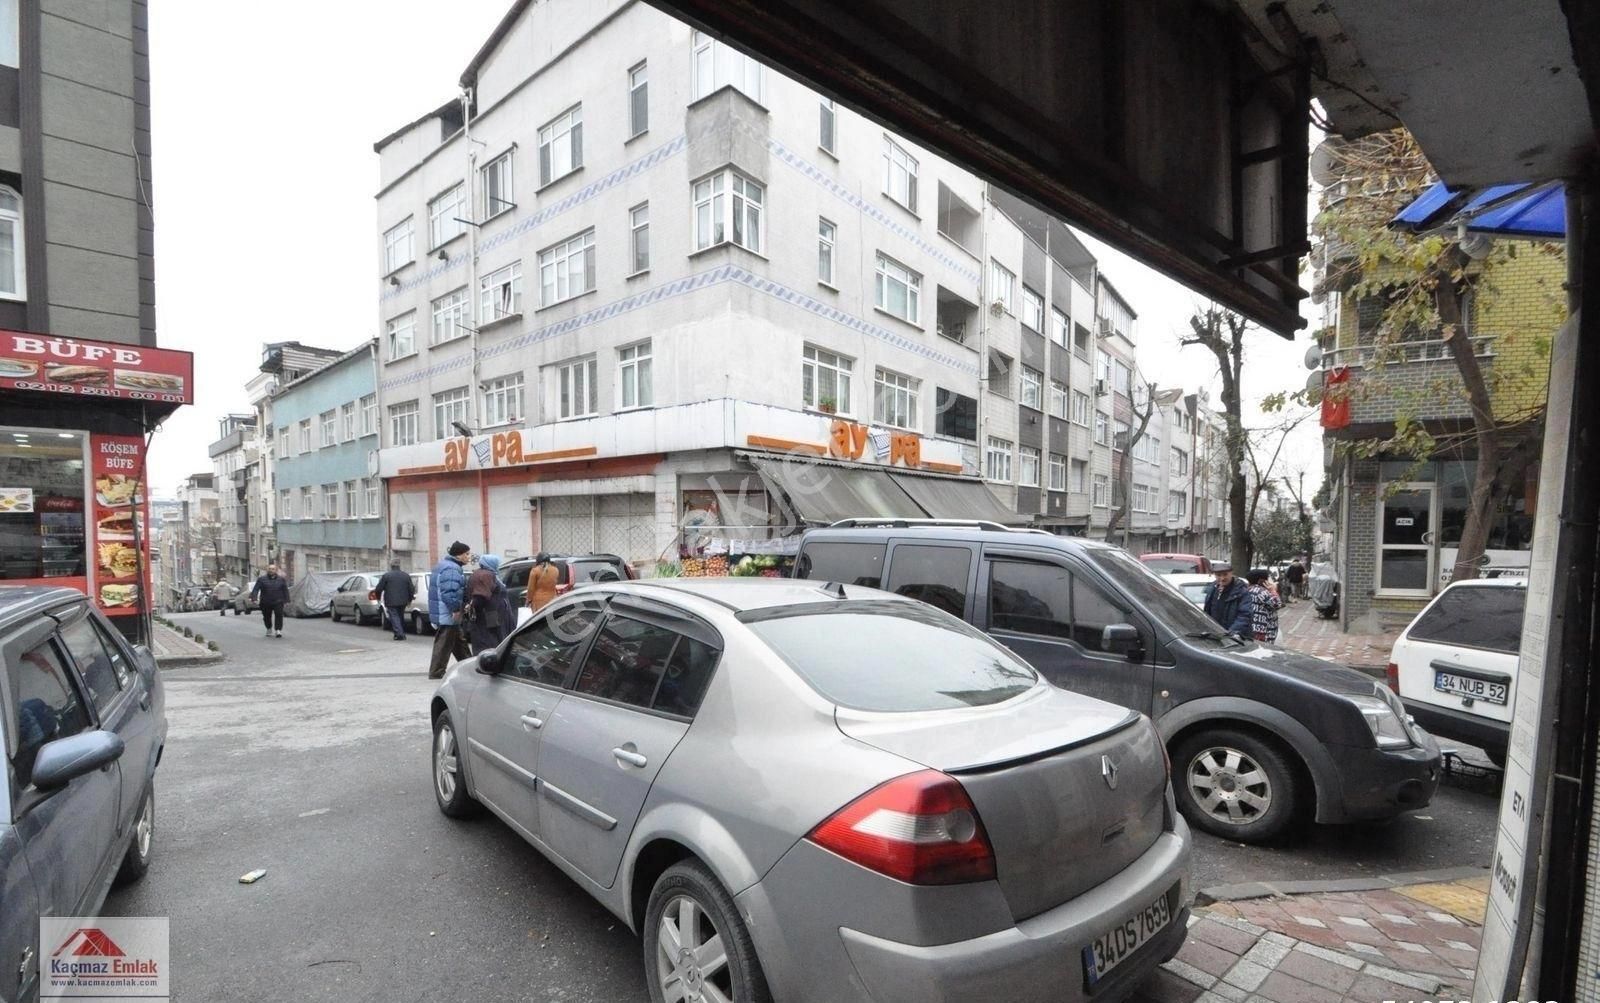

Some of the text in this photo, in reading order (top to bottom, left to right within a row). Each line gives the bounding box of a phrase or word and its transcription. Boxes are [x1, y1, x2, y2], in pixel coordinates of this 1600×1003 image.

[12, 336, 143, 366] BÜFE
[14, 380, 75, 394] 0212
[100, 442, 138, 456] KÖŞEM
[106, 458, 134, 469] BÜFE
[1442, 675, 1505, 699] 34 NUB 52
